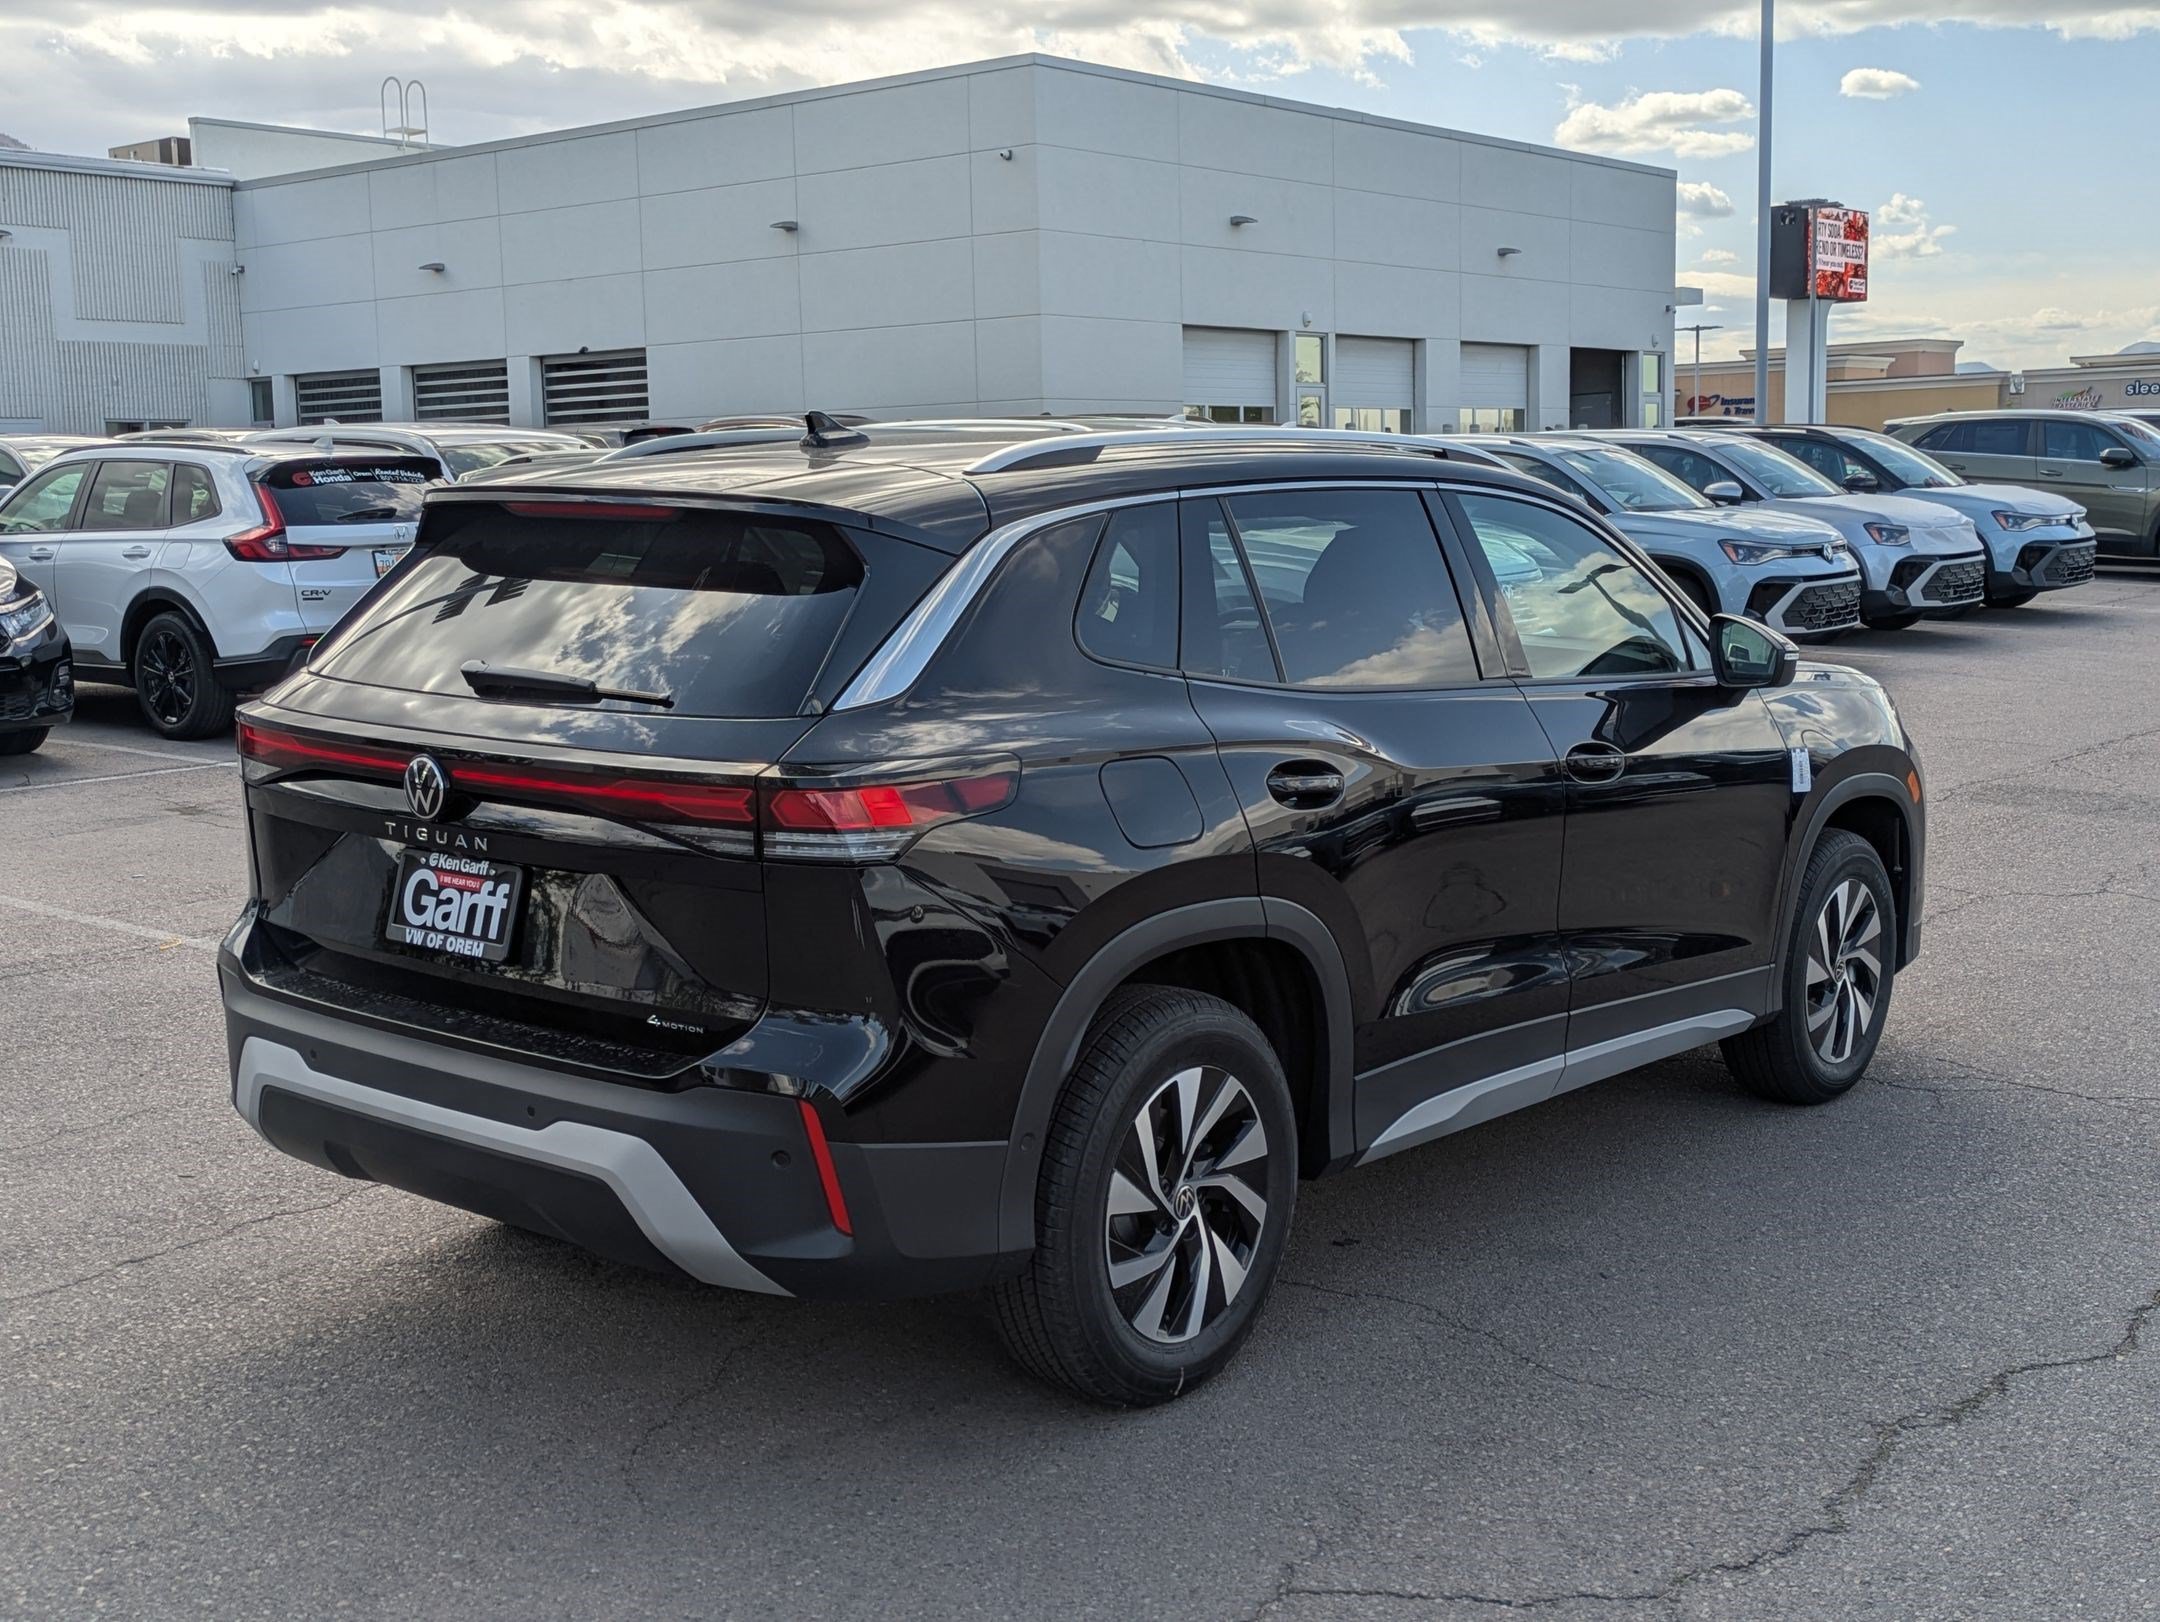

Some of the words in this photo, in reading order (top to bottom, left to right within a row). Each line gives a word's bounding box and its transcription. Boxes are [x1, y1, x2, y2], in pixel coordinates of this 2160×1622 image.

[1720, 397, 1755, 405] Insuran
[312, 474, 353, 484] Honda
[301, 589, 331, 597] CR-V
[385, 821, 488, 851] TIGUAN
[438, 853, 460, 871] Ken
[460, 858, 490, 876] Garff
[452, 878, 466, 886] HEAR
[466, 880, 477, 888] YOU
[403, 868, 510, 940] Garff
[405, 928, 424, 945] VW
[426, 933, 444, 950] OF
[446, 937, 484, 958] OREM
